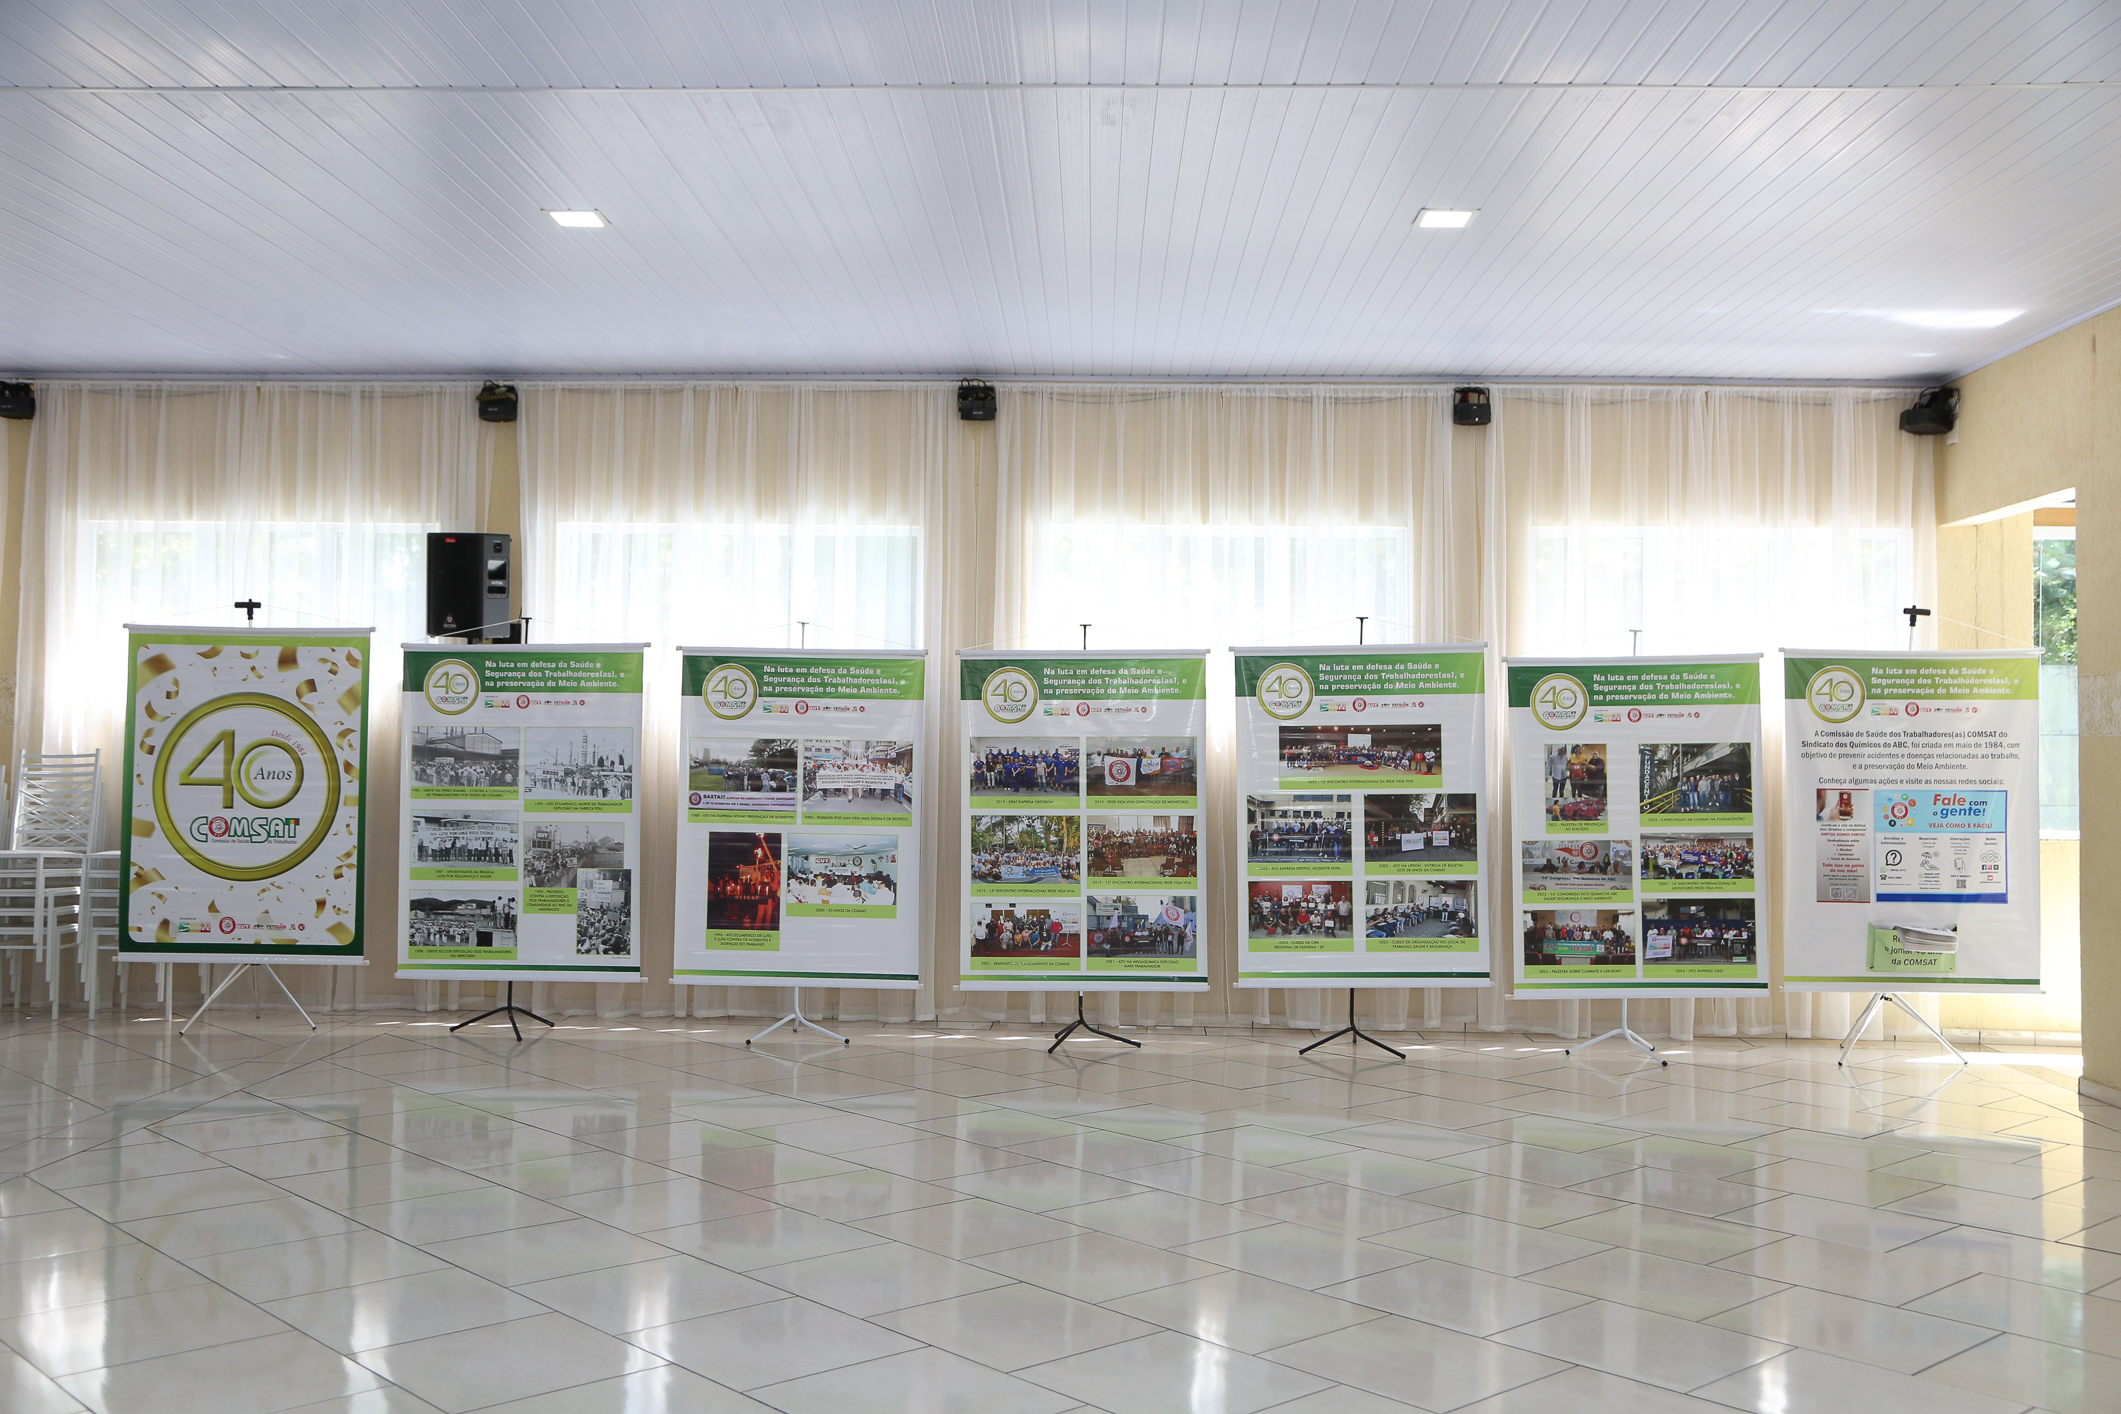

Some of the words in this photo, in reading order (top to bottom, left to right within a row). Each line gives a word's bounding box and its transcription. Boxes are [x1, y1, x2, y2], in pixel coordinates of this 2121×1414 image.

[485, 670, 526, 678] Segurança
[763, 675, 805, 684] Segurança
[823, 676, 898, 684] Trabalhadores(as),
[991, 679, 1027, 702] 40
[1593, 684, 1637, 692] Segurança
[1816, 678, 1854, 702] 40
[271, 730, 292, 742] Desde
[292, 740, 307, 756] 1984
[1800, 751, 1828, 760] objetivo
[179, 729, 304, 809] 40
[253, 767, 292, 780] Anos
[1818, 777, 1847, 785] Conheça
[1848, 778, 1878, 786] algumas
[1933, 794, 1966, 806] Fale
[1940, 807, 1985, 818] gente!
[190, 816, 300, 843] COMSAT
